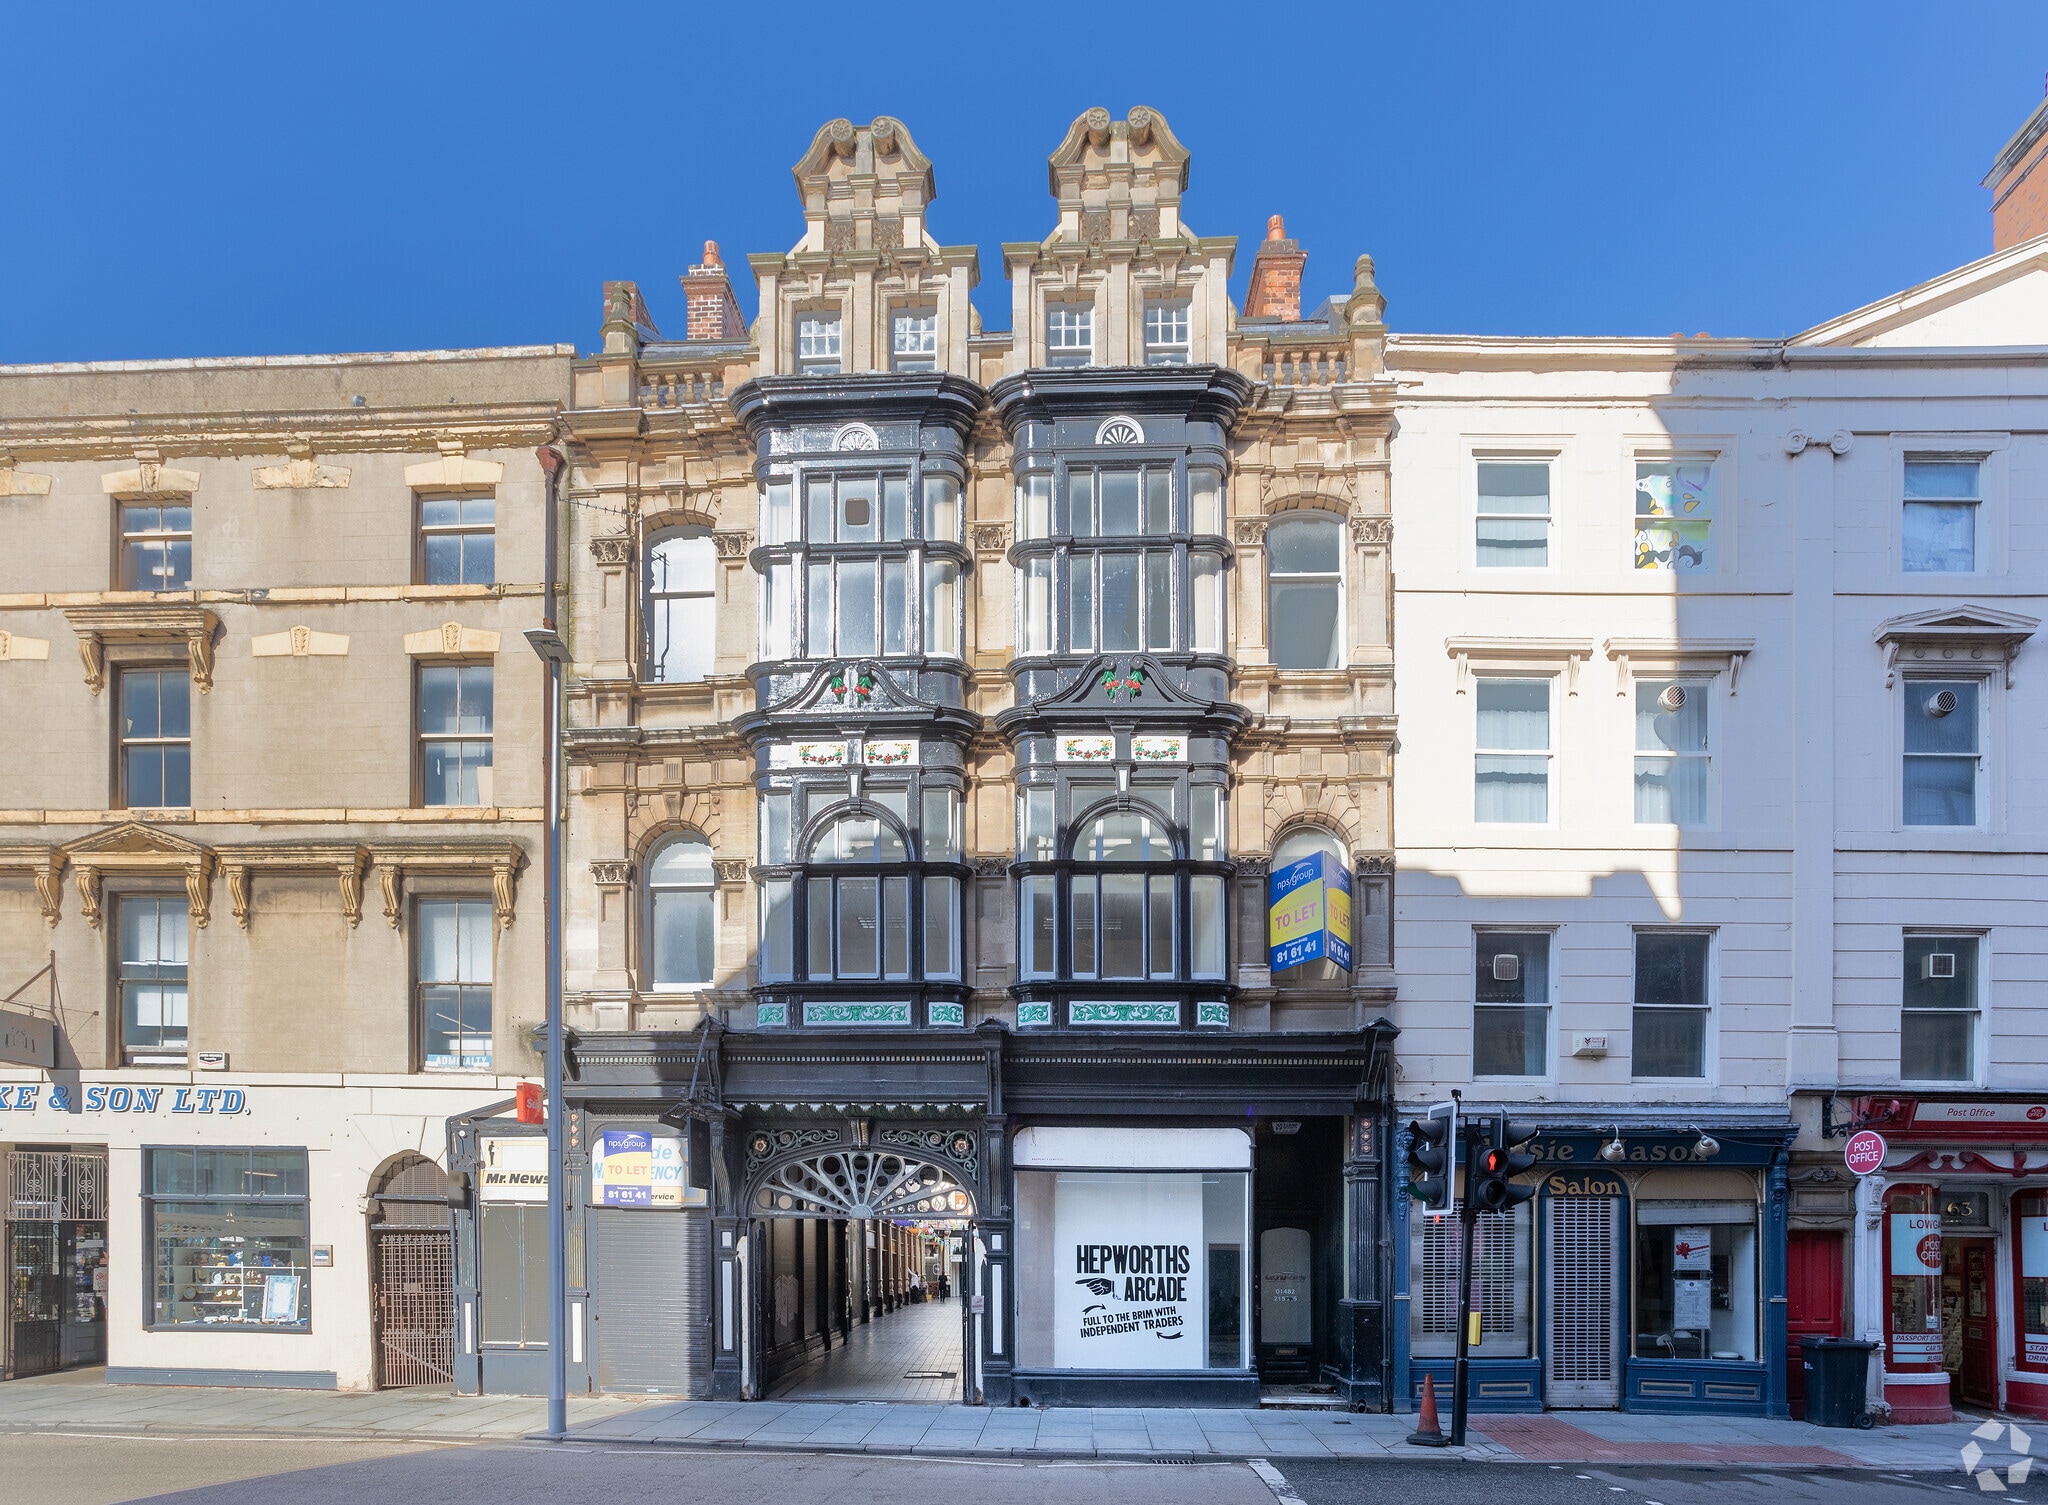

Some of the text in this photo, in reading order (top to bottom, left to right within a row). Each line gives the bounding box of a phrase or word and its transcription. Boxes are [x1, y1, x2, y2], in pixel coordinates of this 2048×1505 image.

[1275, 913, 1291, 931] TO
[1294, 902, 1318, 925] LET
[1277, 950, 1288, 963] 81
[1290, 945, 1302, 958] 61
[1305, 940, 1317, 953] 41
[436, 1056, 486, 1066] ADMIALTY
[49, 1085, 72, 1112] &
[85, 1087, 163, 1114] SON
[171, 1088, 251, 1115] LTD.
[1947, 1108, 1995, 1117] Post Office
[1854, 1140, 1876, 1152] POST
[1849, 1151, 1879, 1164] OFFICE
[608, 1165, 622, 1175] TO
[627, 1165, 648, 1175] LET
[651, 1166, 682, 1180] ENCY
[485, 1173, 506, 1184] Mr.
[1549, 1176, 1622, 1195] Salon
[608, 1191, 647, 1199] 81 61 41
[1947, 1202, 1973, 1216] 63
[1076, 1245, 1190, 1274] HEPWORTHS
[1920, 1251, 1941, 1261] OFFIC
[1124, 1277, 1187, 1301] ARCADE
[1083, 1306, 1176, 1326] FULL TO THE BRIM WITH
[1080, 1315, 1184, 1338] INDEPENDENT TRADERS
